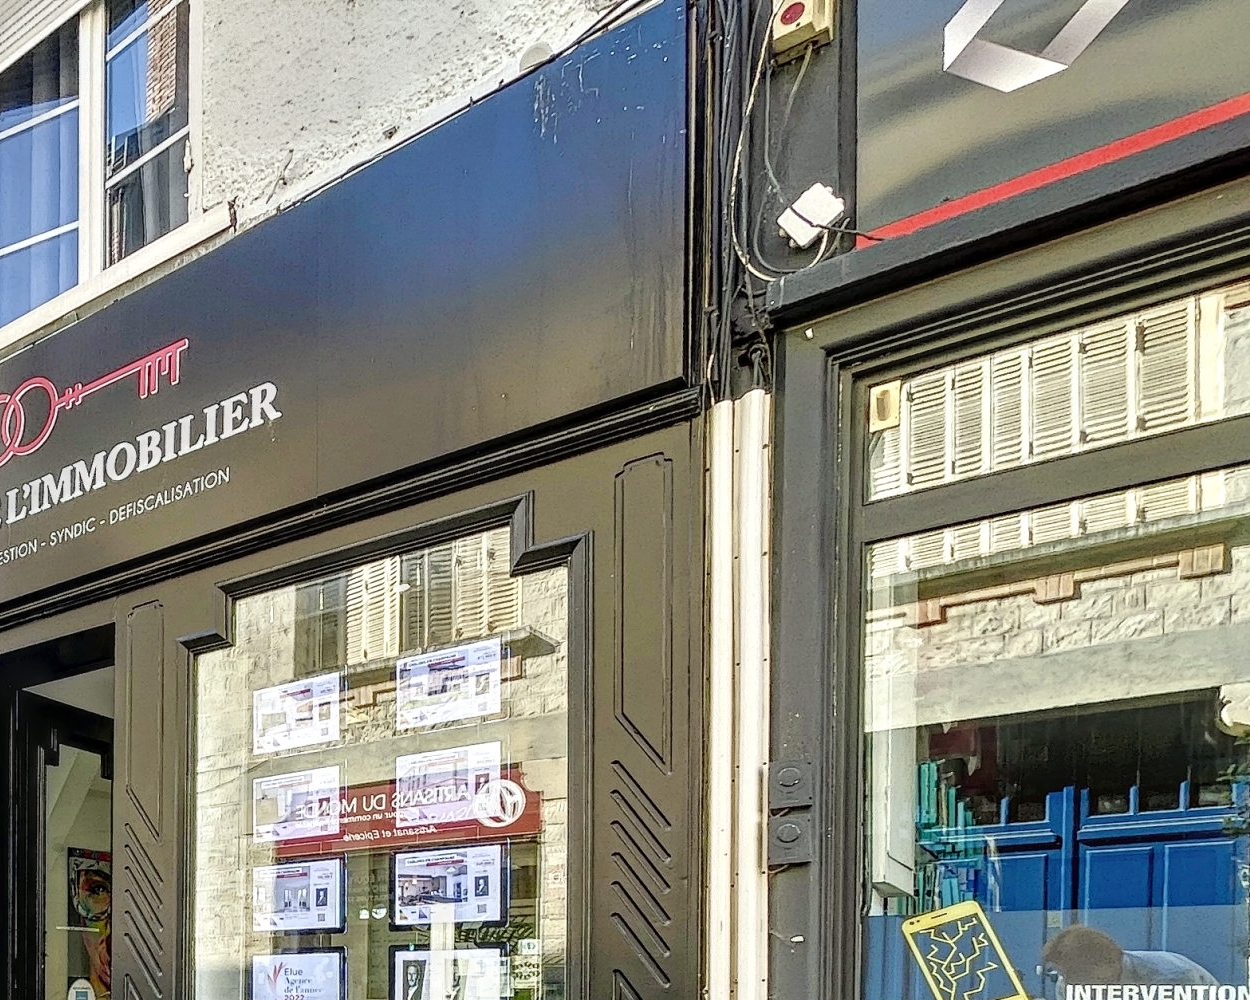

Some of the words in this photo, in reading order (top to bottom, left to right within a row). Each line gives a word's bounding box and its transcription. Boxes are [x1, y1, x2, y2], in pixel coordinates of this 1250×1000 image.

[5, 381, 283, 525] L'IMMOBILIER
[49, 517, 96, 547] SYNDIC
[109, 467, 231, 525] DEFISCALISATION
